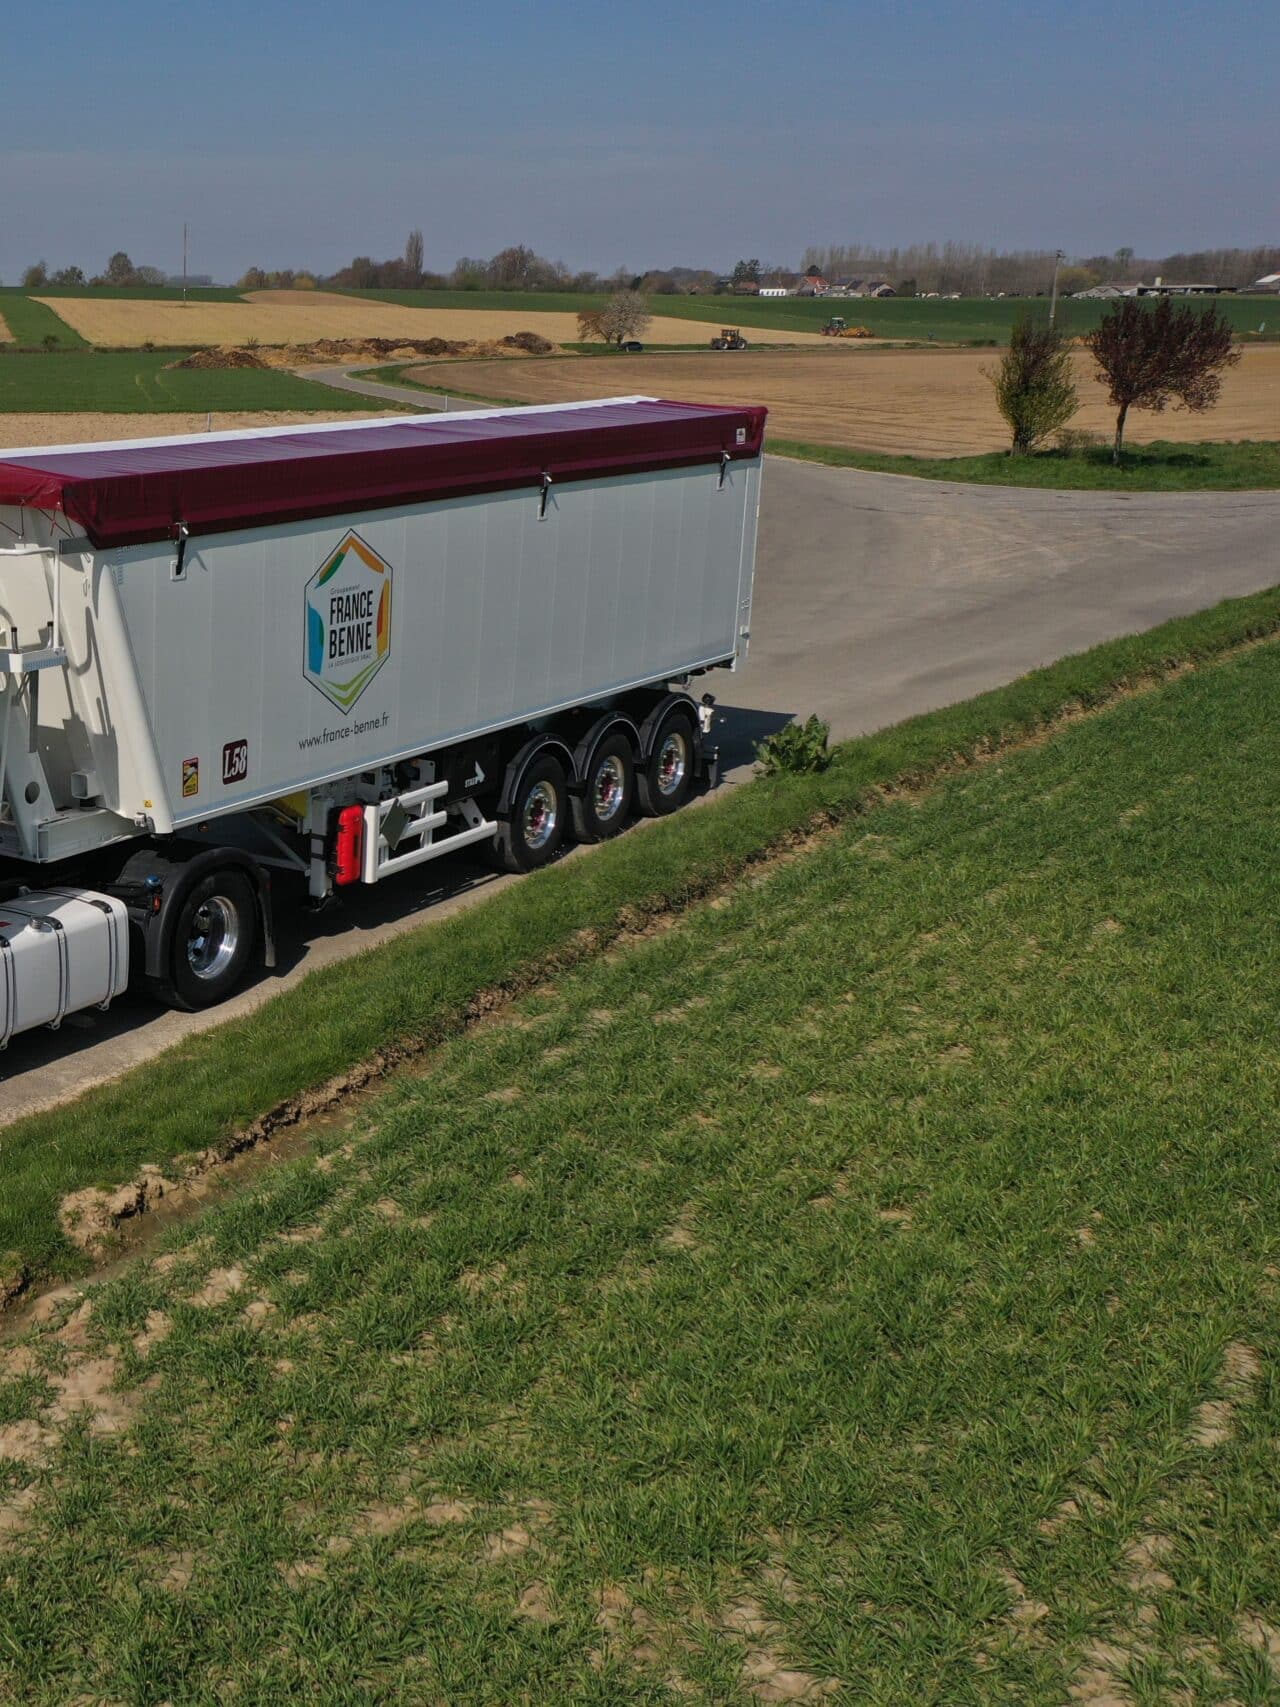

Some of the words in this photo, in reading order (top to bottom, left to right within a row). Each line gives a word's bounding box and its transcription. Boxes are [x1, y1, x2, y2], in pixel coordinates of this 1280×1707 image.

[329, 590, 373, 625] FRANCE
[329, 621, 372, 659] BENNE
[298, 712, 390, 750] www.france-benne.fr
[223, 744, 247, 779] L58
